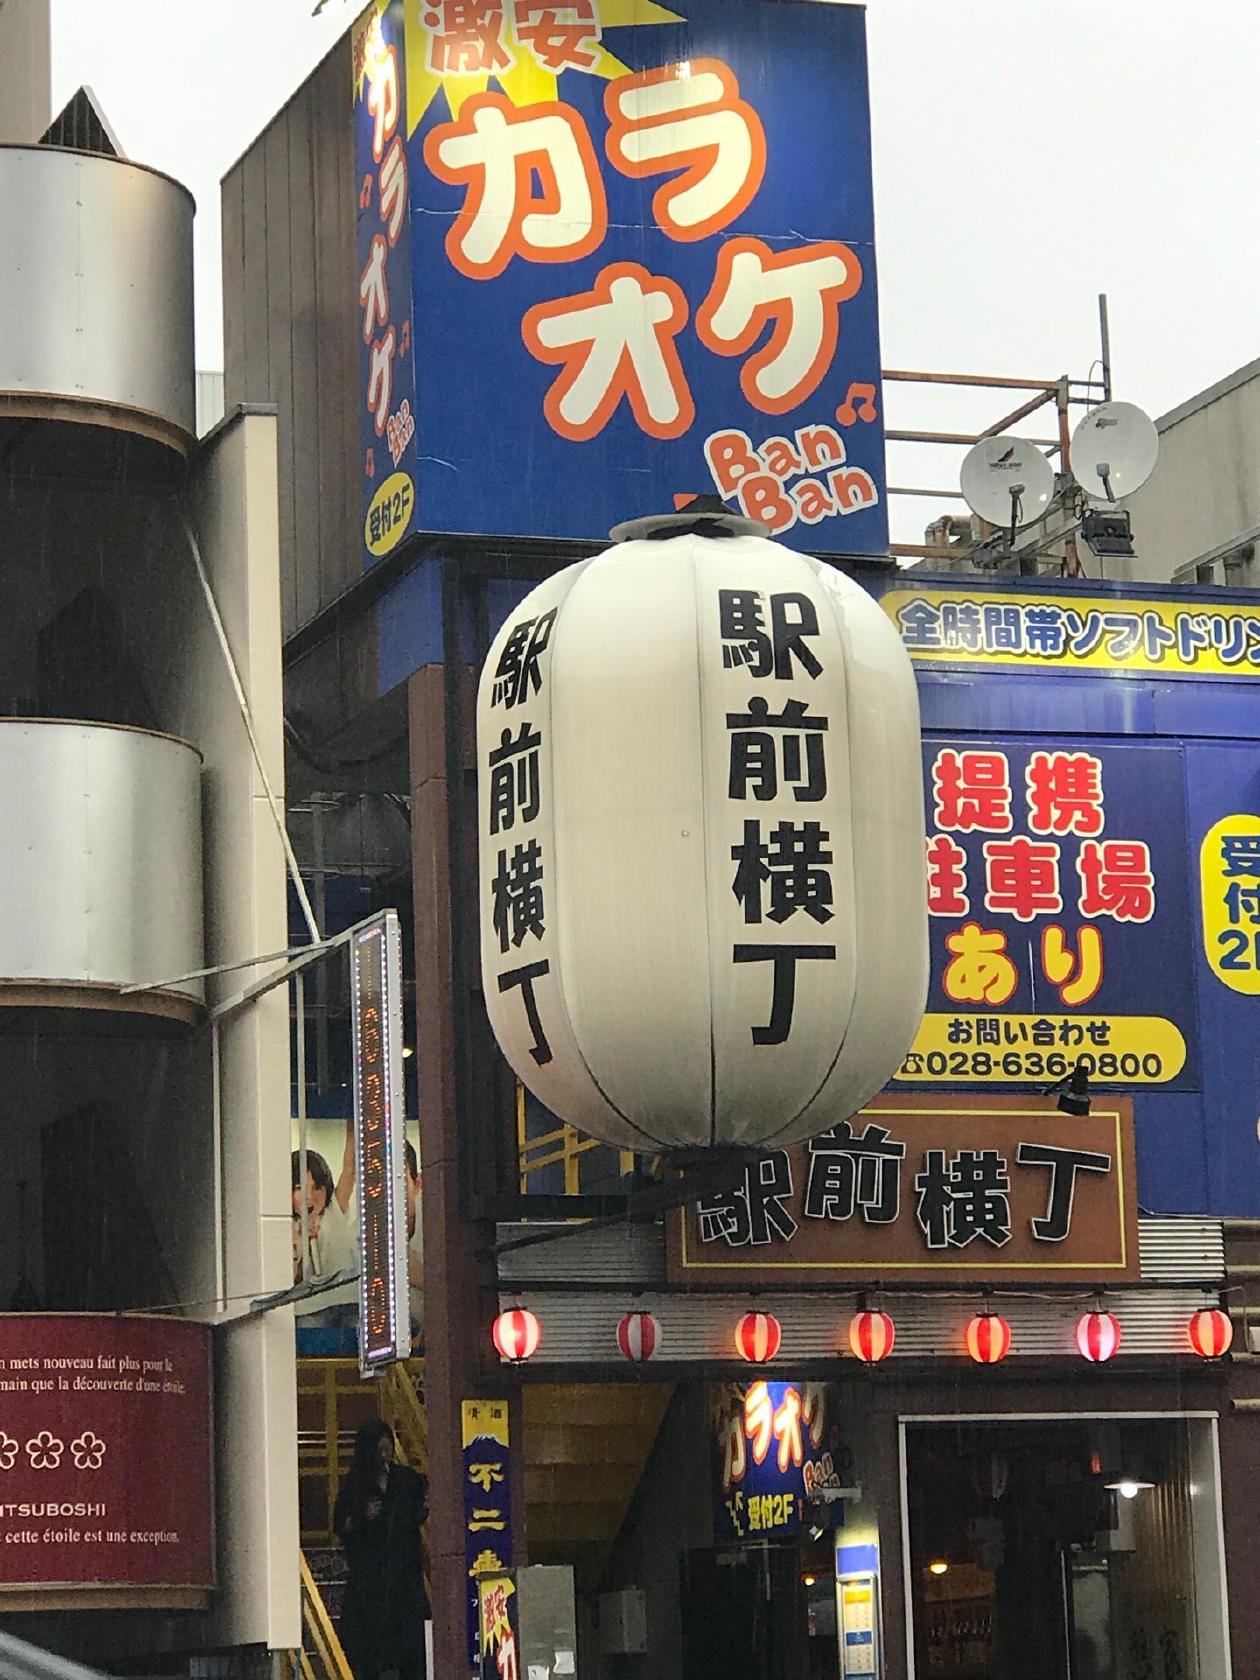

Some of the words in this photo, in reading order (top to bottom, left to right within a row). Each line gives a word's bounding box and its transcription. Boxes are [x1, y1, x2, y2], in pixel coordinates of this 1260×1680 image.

[422, 0, 600, 74] 激安
[704, 424, 846, 500] Ban
[369, 484, 411, 546] 受付2F
[736, 466, 878, 536] Ban
[718, 588, 837, 1047] 駅前横丁
[933, 749, 1105, 835] 提携
[490, 606, 558, 1068] 駅前横丁
[943, 921, 1104, 1006] あり
[947, 1018, 1112, 1046] お問い合わせ
[10, 1356, 40, 1370] mets
[43, 1356, 94, 1370] nouveau
[97, 1355, 117, 1370] fait
[119, 1355, 140, 1373] plus
[31, 1379, 54, 1394] que
[58, 1376, 69, 1391] la
[5, 1530, 39, 1544] cette
[43, 1528, 81, 1543] étoile
[84, 1529, 103, 1543] est
[106, 1531, 128, 1543] une
[747, 1493, 794, 1531] 受付2F
